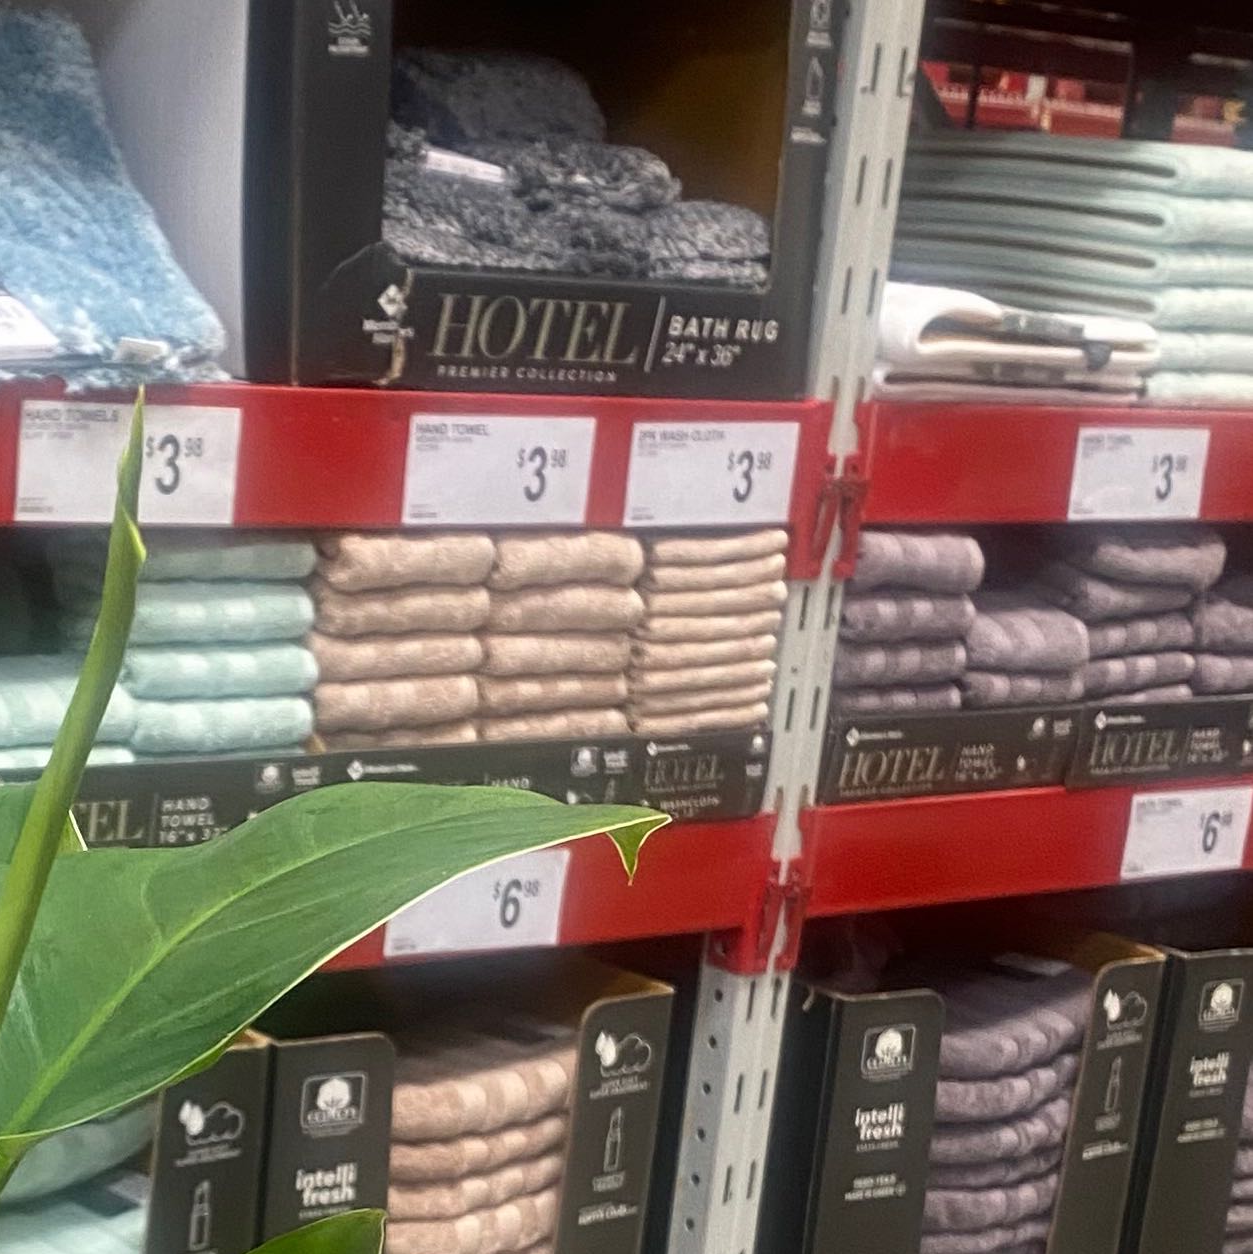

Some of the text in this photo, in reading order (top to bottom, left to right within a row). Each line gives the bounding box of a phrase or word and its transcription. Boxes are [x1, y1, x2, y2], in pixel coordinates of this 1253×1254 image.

[429, 293, 637, 364] HOTEL
[667, 315, 778, 342] BATH RUG
[437, 364, 617, 382] PREMIER COLLECTION
[838, 747, 944, 786] HOTEL
[162, 813, 215, 827] TOWEL
[855, 1102, 904, 1127] intelli
[860, 1123, 904, 1140] fresh
[296, 1163, 357, 1190] intelli
[303, 1186, 356, 1207] fresh
